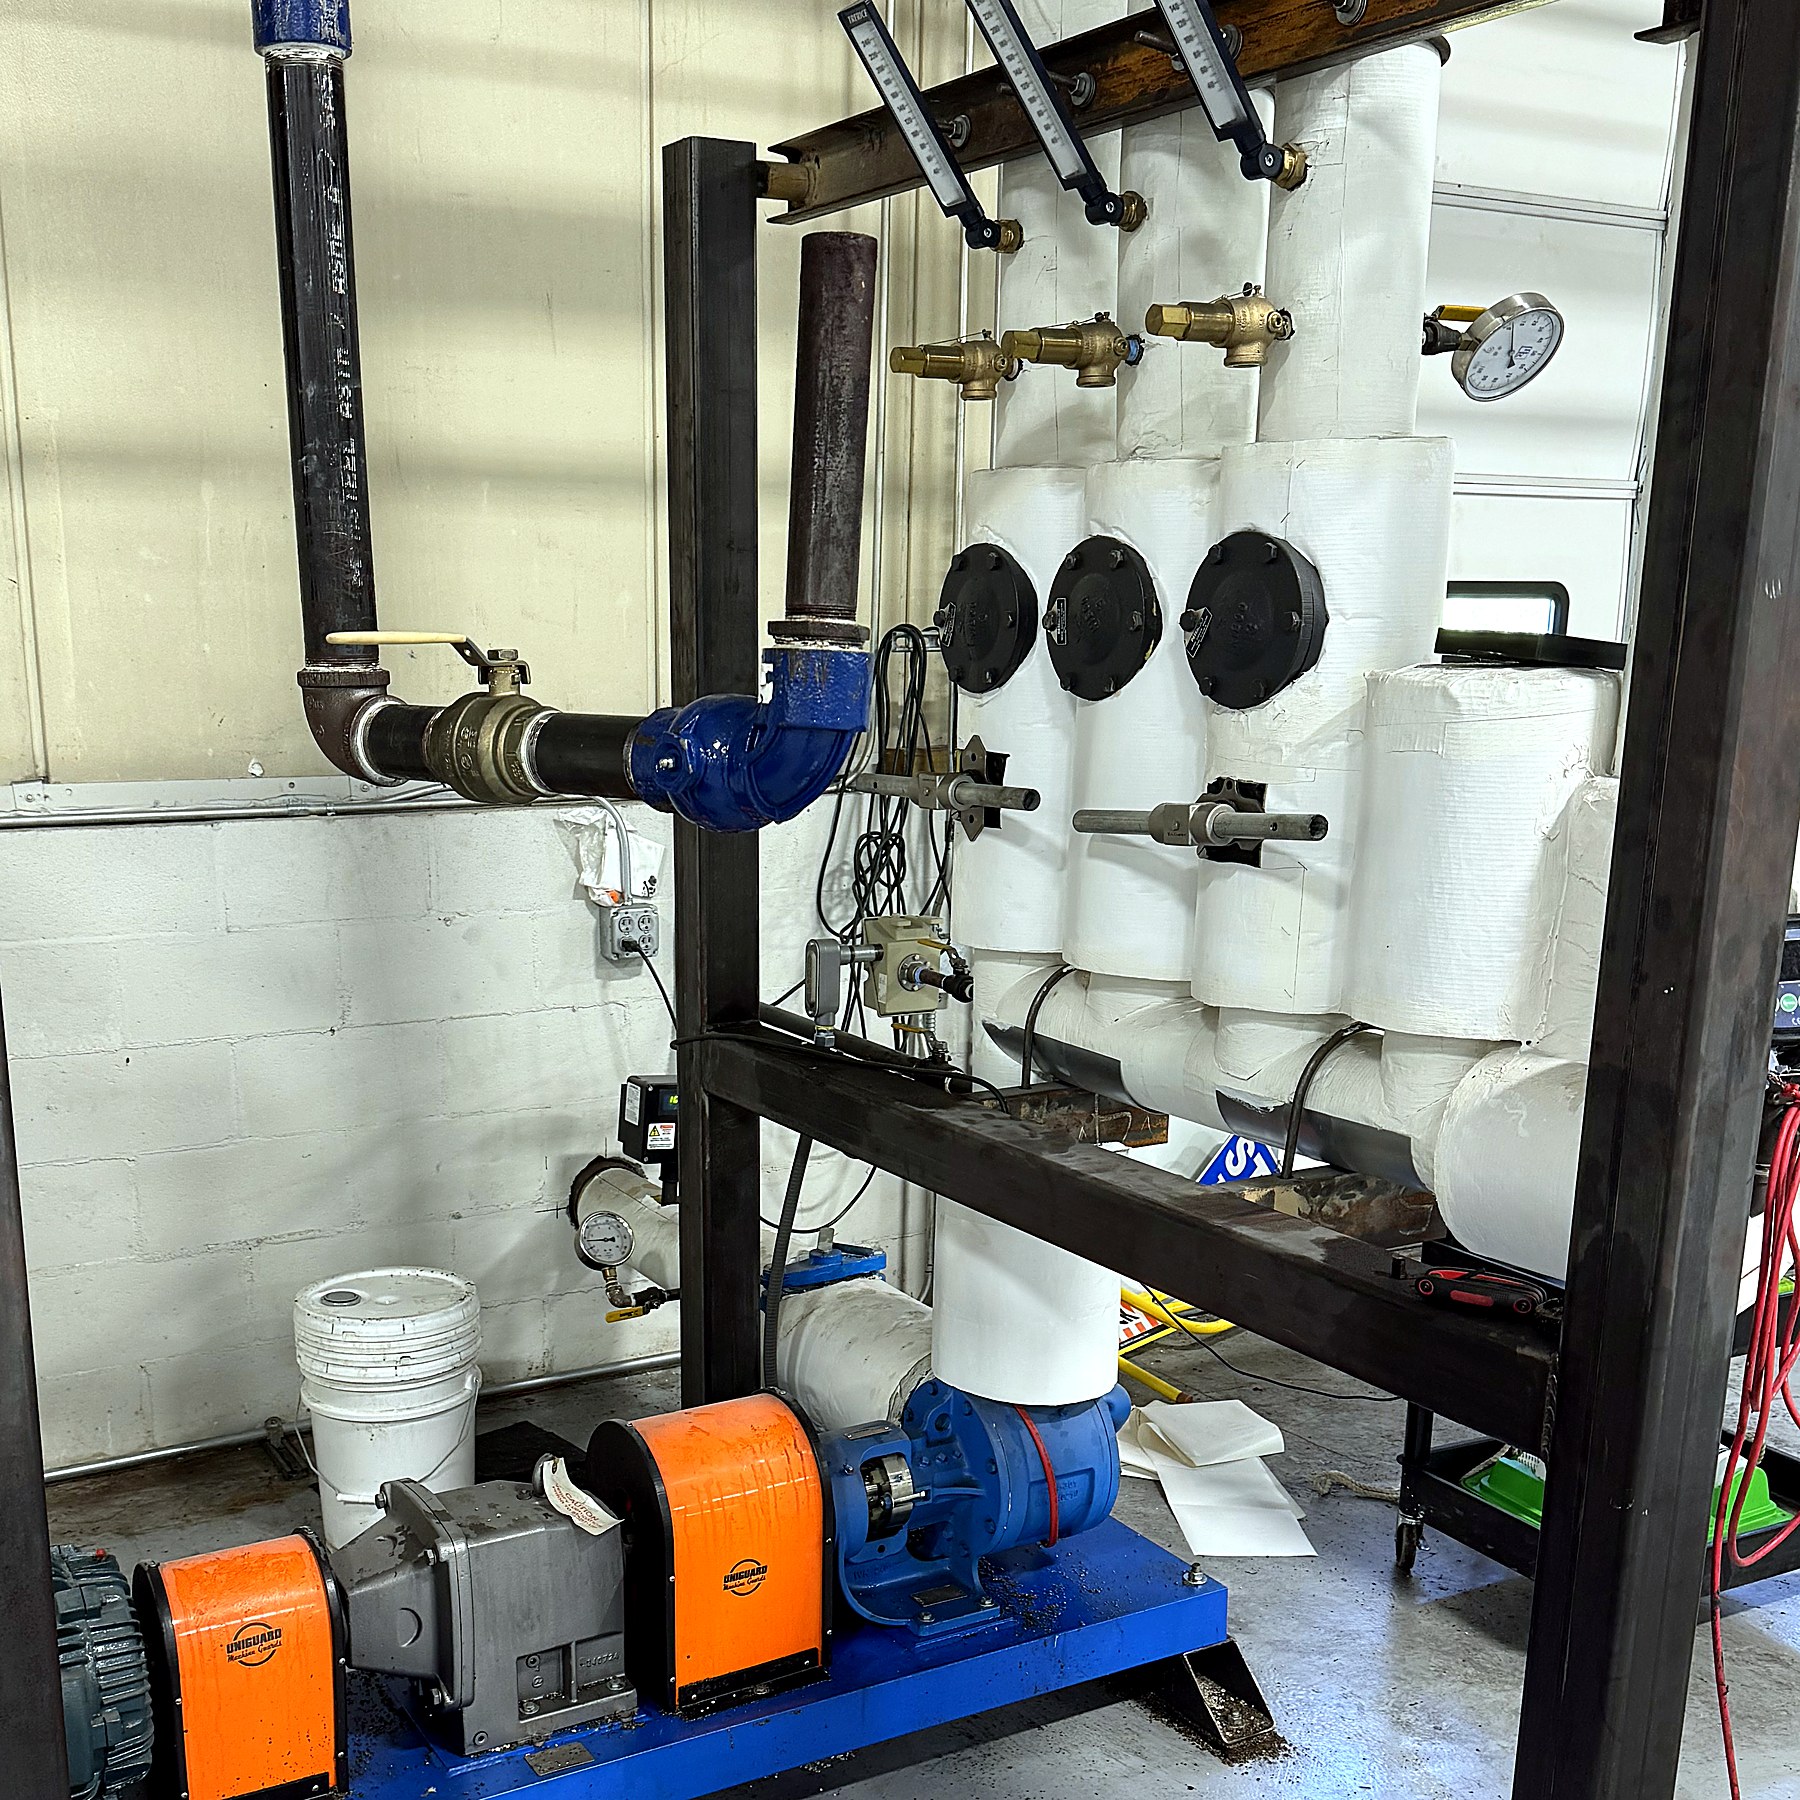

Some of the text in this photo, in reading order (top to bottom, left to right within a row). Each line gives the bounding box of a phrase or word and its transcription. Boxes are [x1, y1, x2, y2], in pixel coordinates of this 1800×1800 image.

[565, 1492, 600, 1521] CAUTION
[723, 1564, 768, 1584] UNIGUARD
[226, 1628, 282, 1654] UNIGUARD
